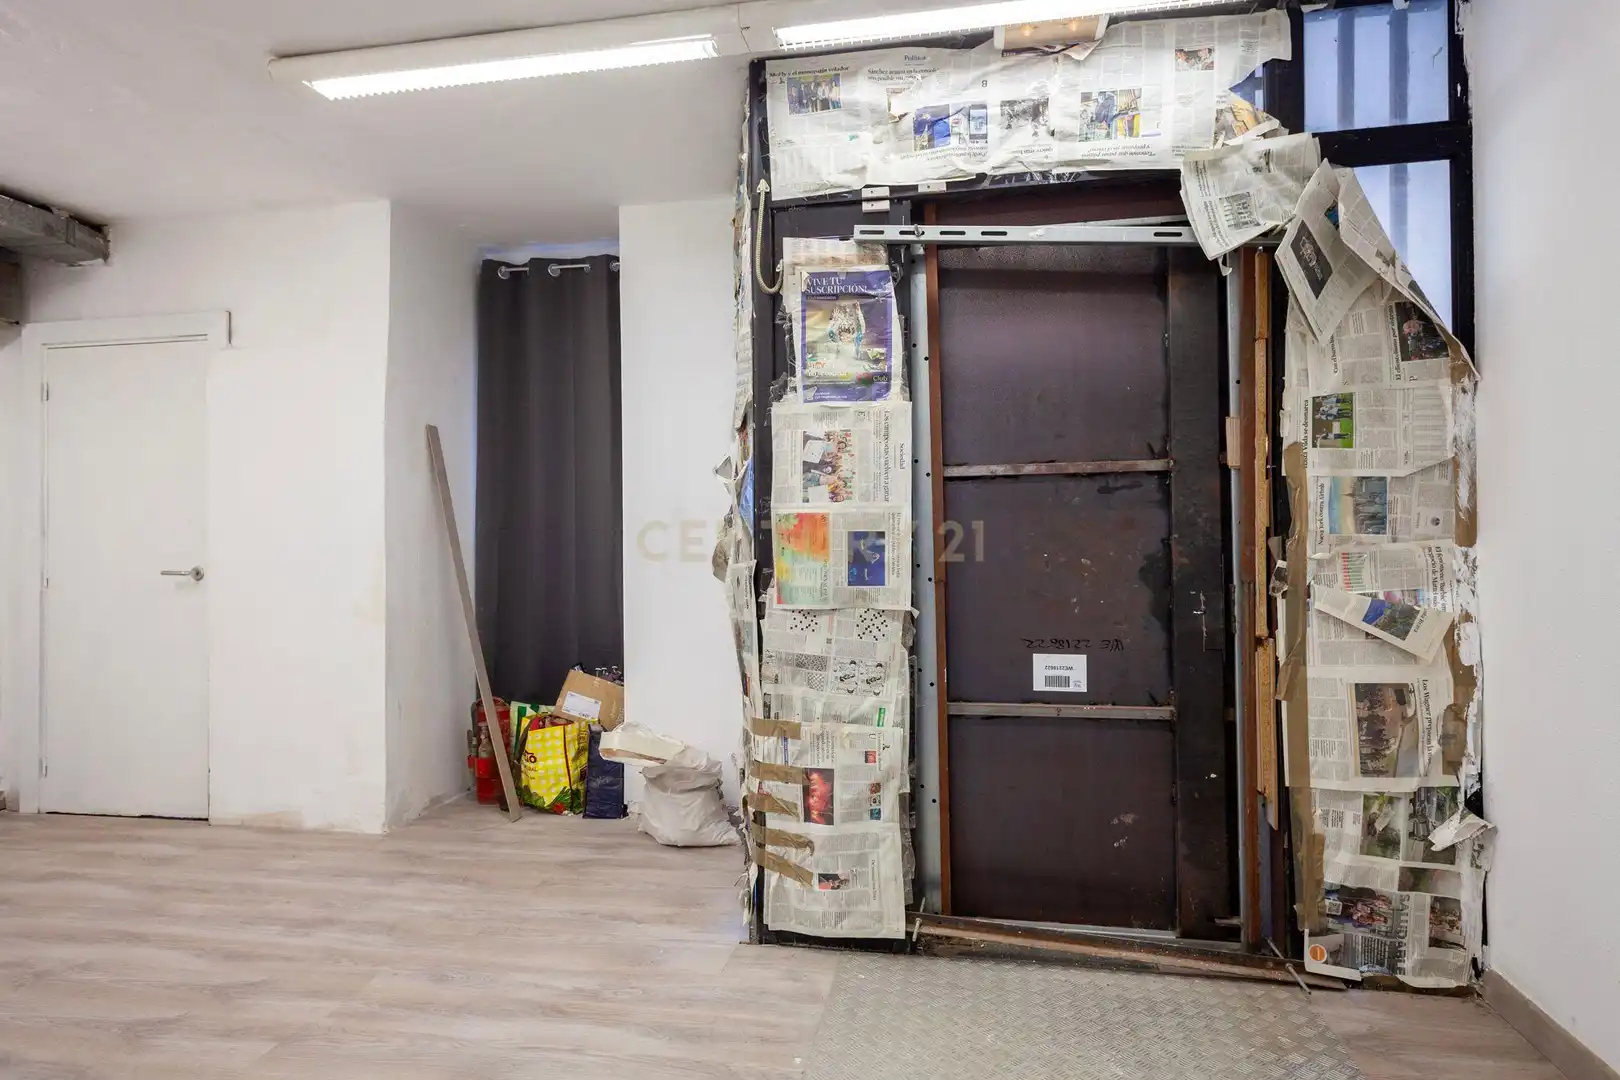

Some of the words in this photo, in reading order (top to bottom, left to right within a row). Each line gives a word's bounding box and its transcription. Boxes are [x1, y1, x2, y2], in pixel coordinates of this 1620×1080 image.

[807, 277, 828, 286] VIVE
[829, 277, 843, 285] TU
[1396, 894, 1410, 975] SALUDABLE
